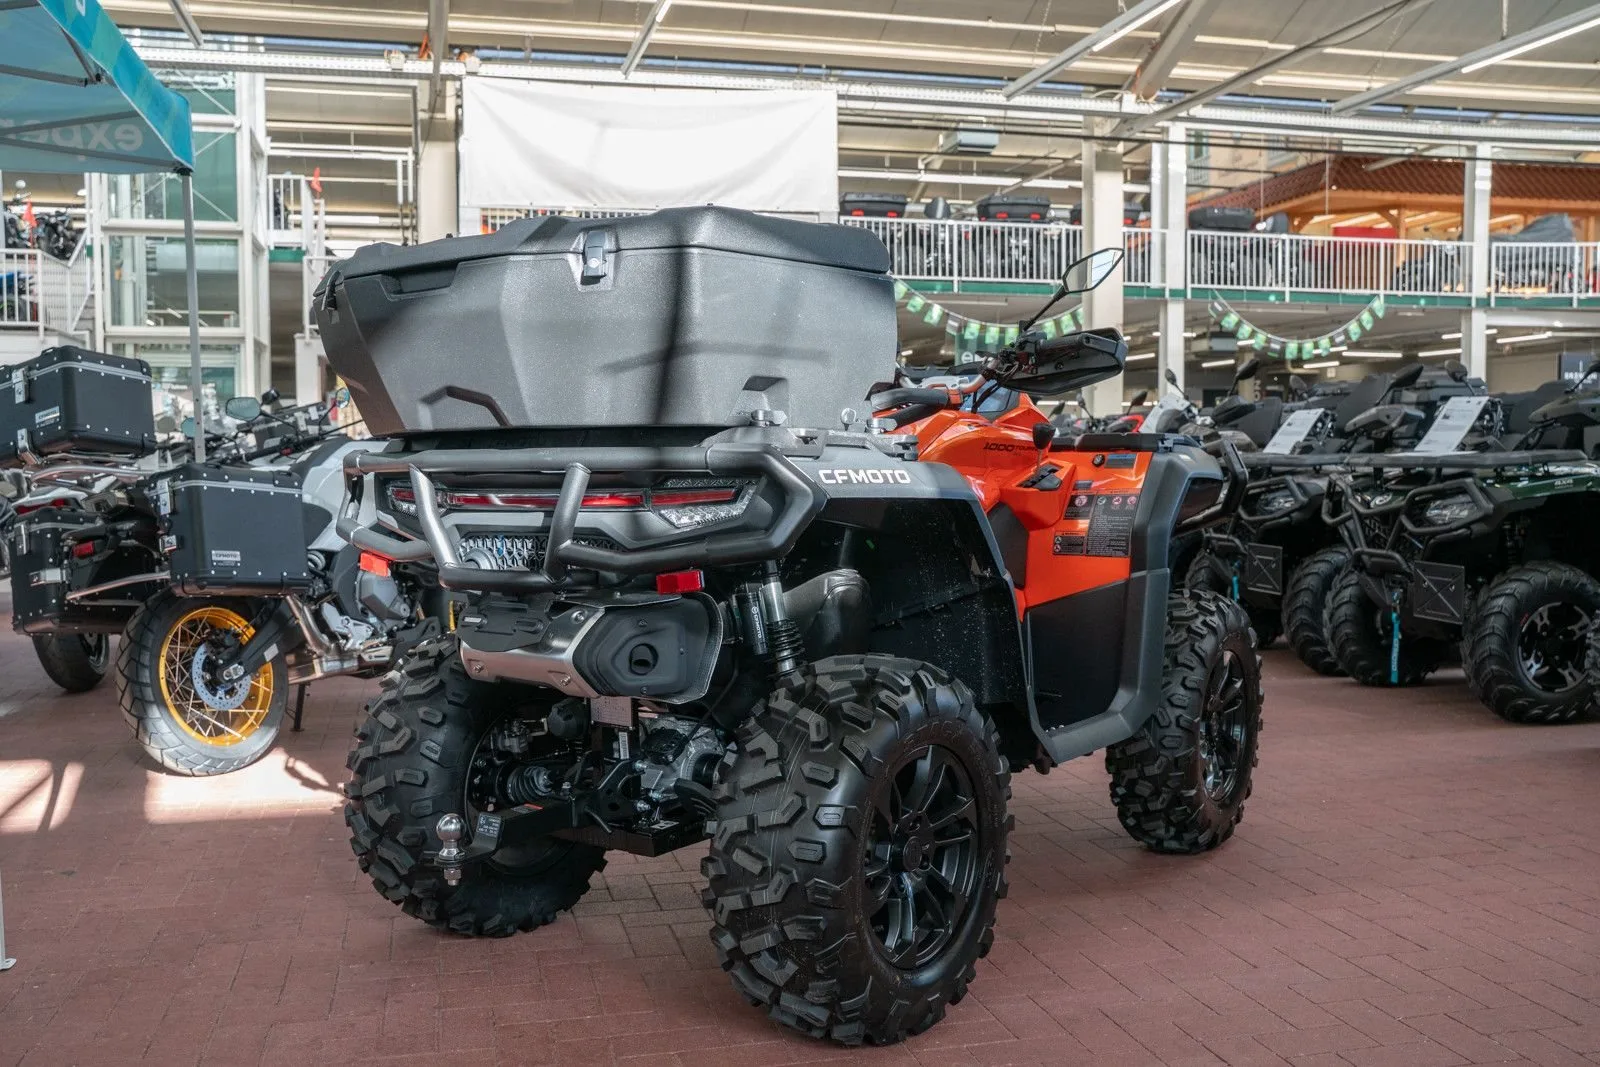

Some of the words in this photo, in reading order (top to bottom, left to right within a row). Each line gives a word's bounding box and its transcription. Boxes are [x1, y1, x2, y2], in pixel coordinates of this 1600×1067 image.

[983, 441, 1015, 452] 1000
[818, 469, 911, 484] CFMOTO
[753, 614, 762, 639] CFMOTO
